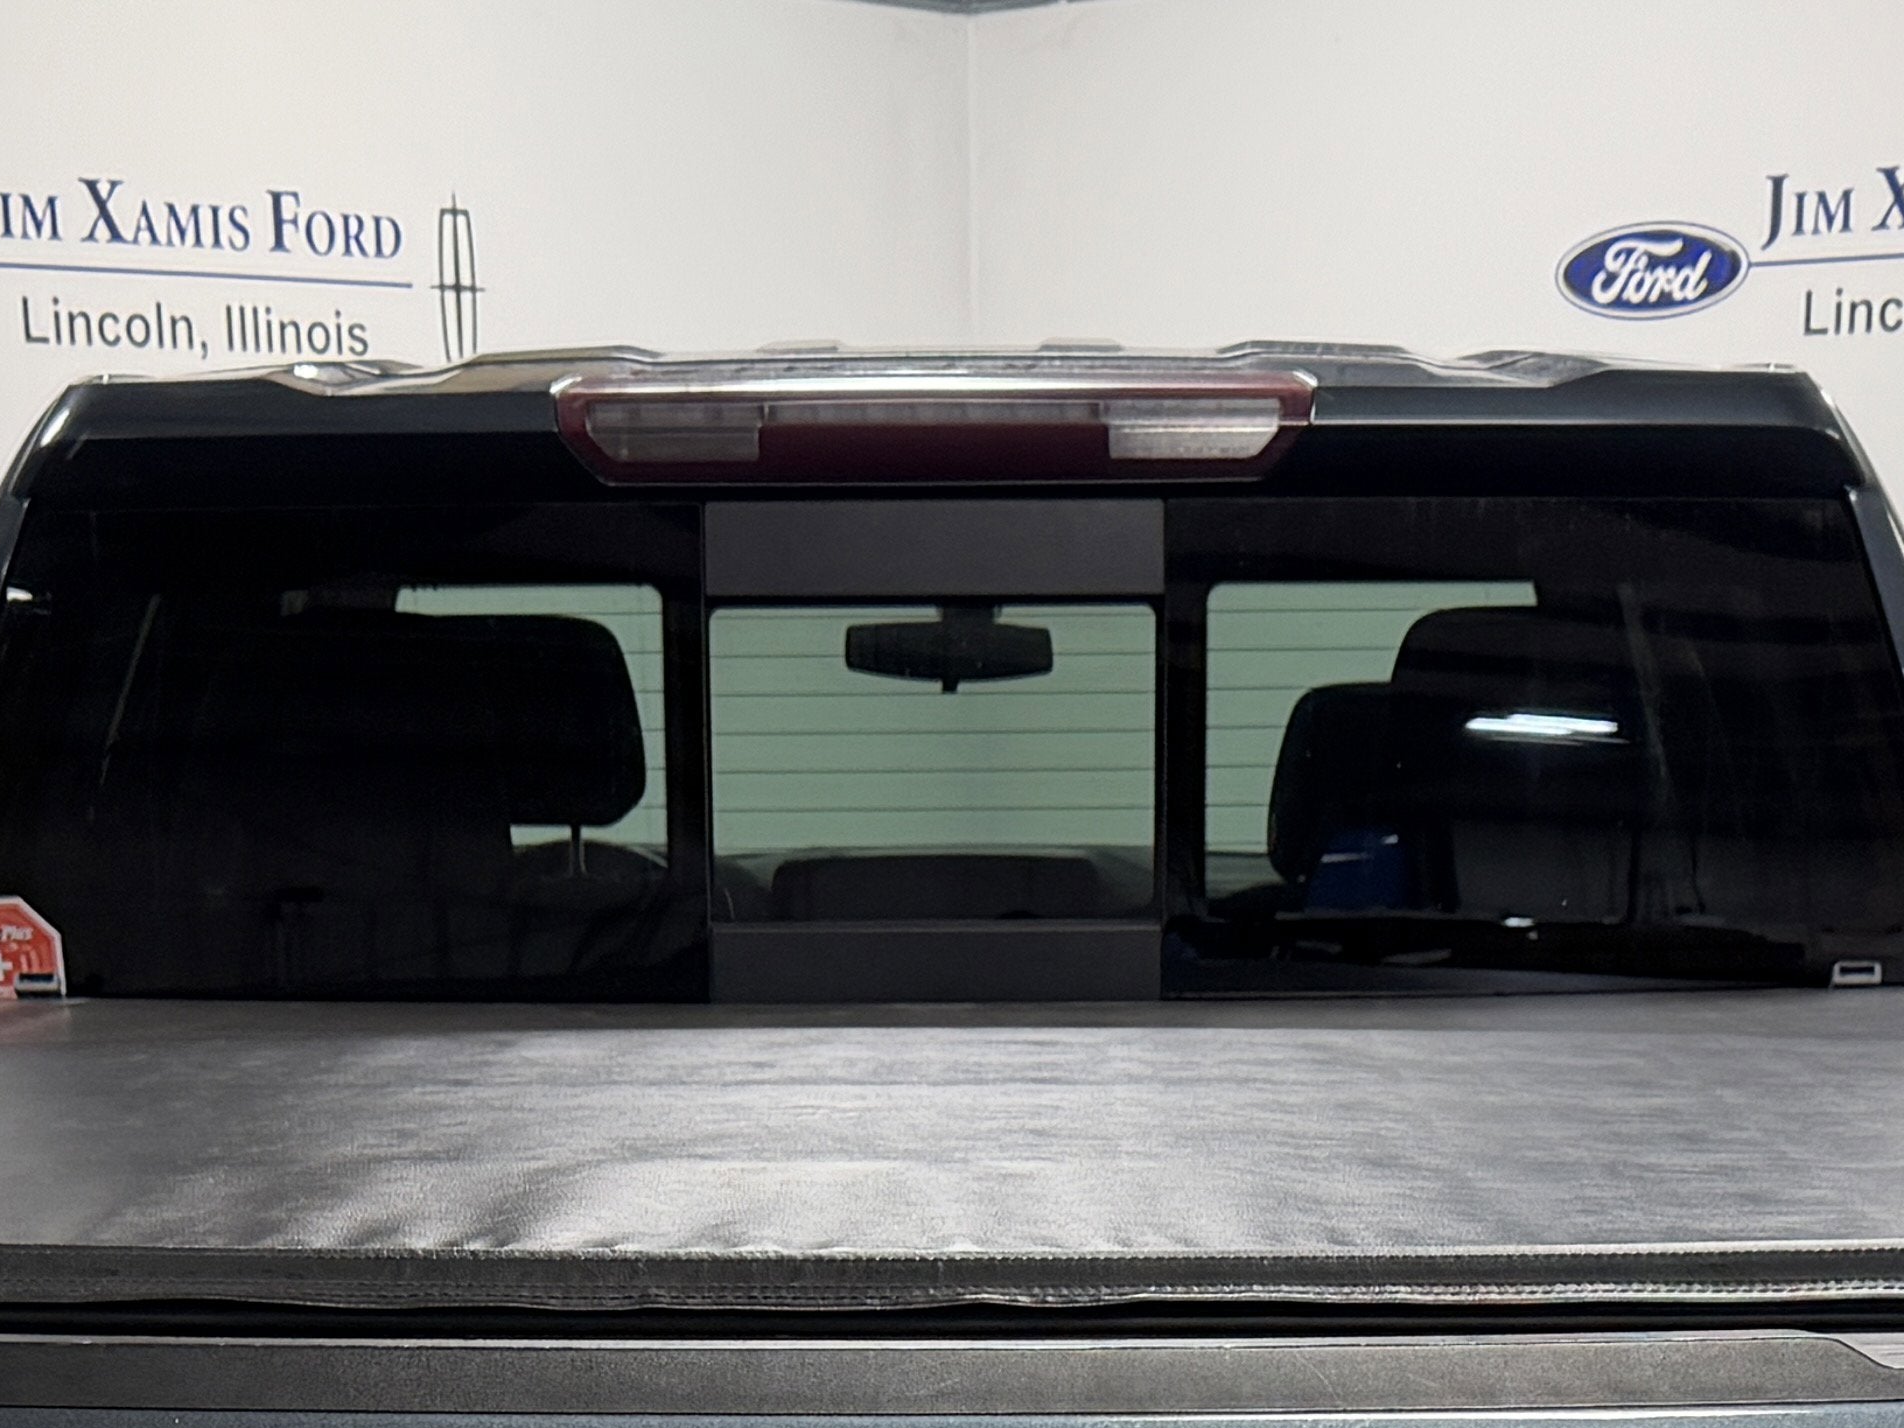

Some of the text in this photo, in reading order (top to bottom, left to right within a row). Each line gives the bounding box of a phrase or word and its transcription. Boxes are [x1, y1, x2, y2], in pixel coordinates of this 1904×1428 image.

[1589, 239, 1710, 306] Ford
[20, 296, 371, 359] Lincoln, Illinois
